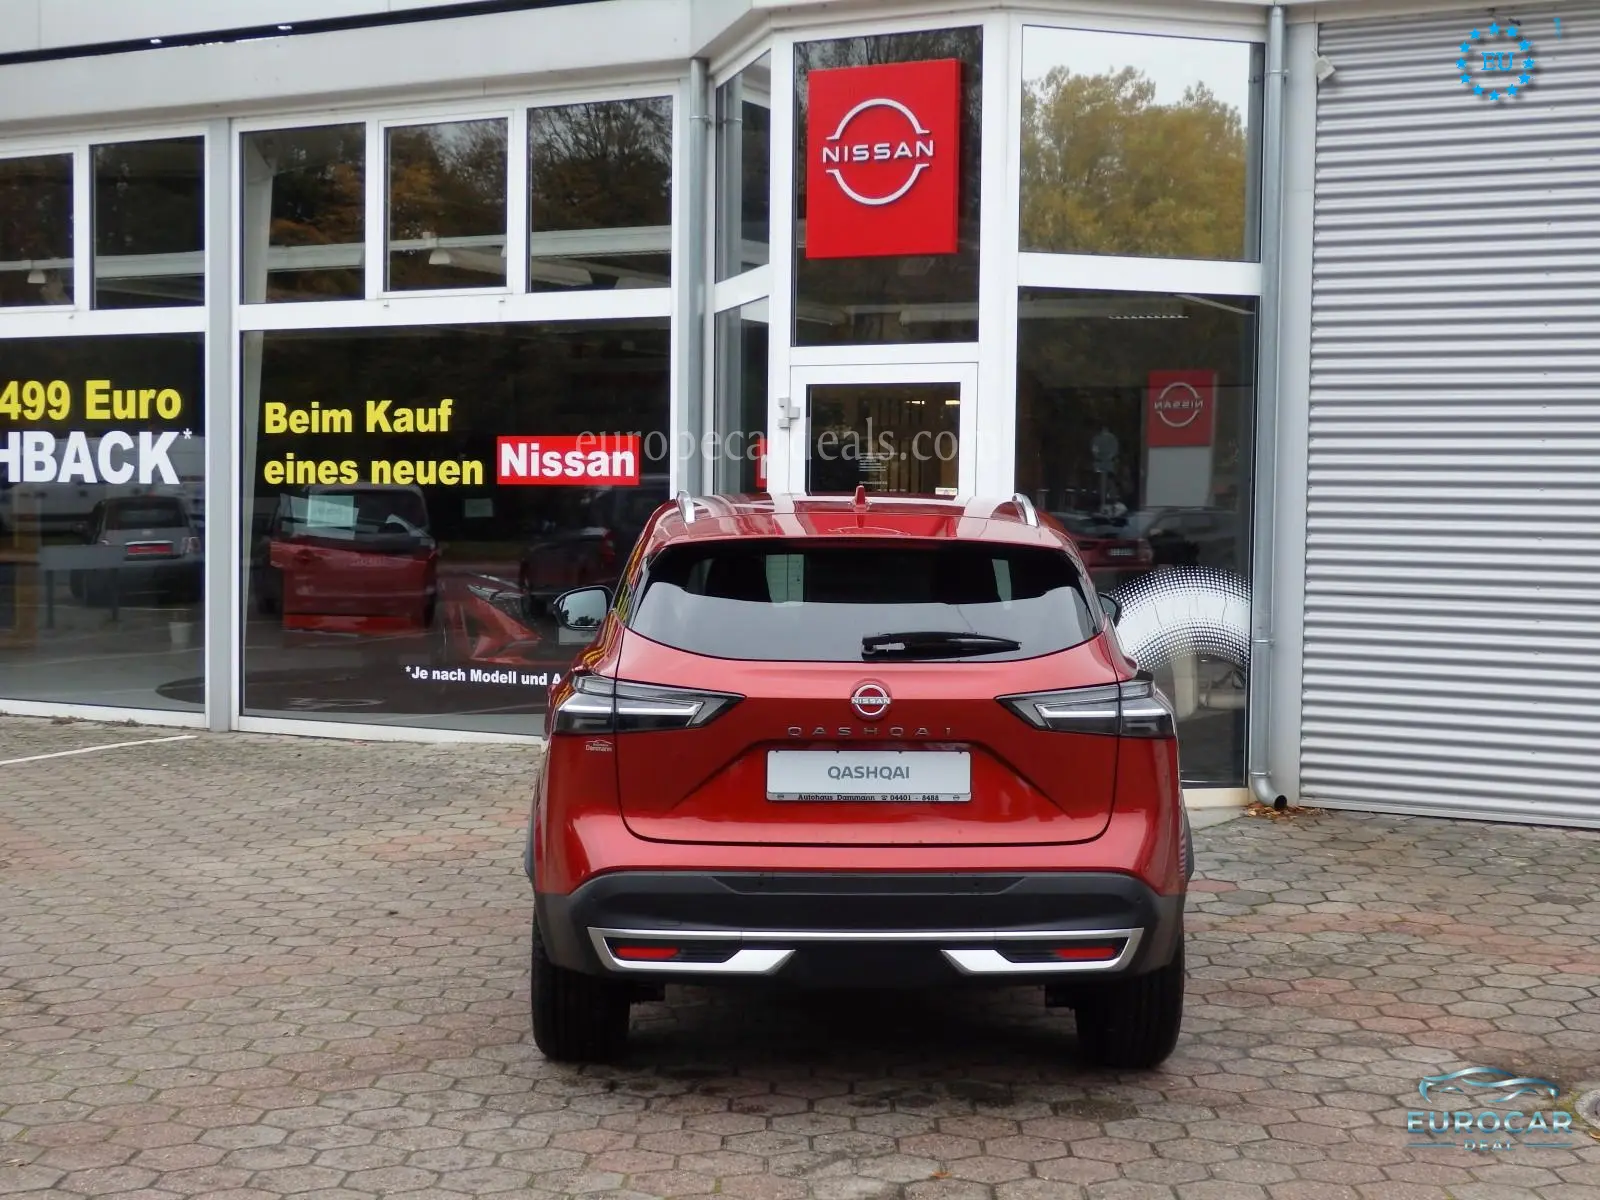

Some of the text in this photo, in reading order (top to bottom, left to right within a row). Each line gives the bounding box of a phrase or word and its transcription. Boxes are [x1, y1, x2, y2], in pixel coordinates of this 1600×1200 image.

[822, 140, 934, 164] NISSAN
[0, 380, 182, 420] 499 Euro
[265, 398, 454, 434] Beim Kauf
[264, 442, 636, 485] eines neuen Nissan
[432, 668, 466, 682] nach
[470, 669, 517, 684] Modell
[521, 672, 548, 686] und
[851, 697, 891, 705] NISSAN
[787, 726, 953, 737] QASHQAI
[827, 765, 911, 781] QASHQAI
[798, 793, 833, 801] Autohaus
[837, 793, 876, 801] Dammann
